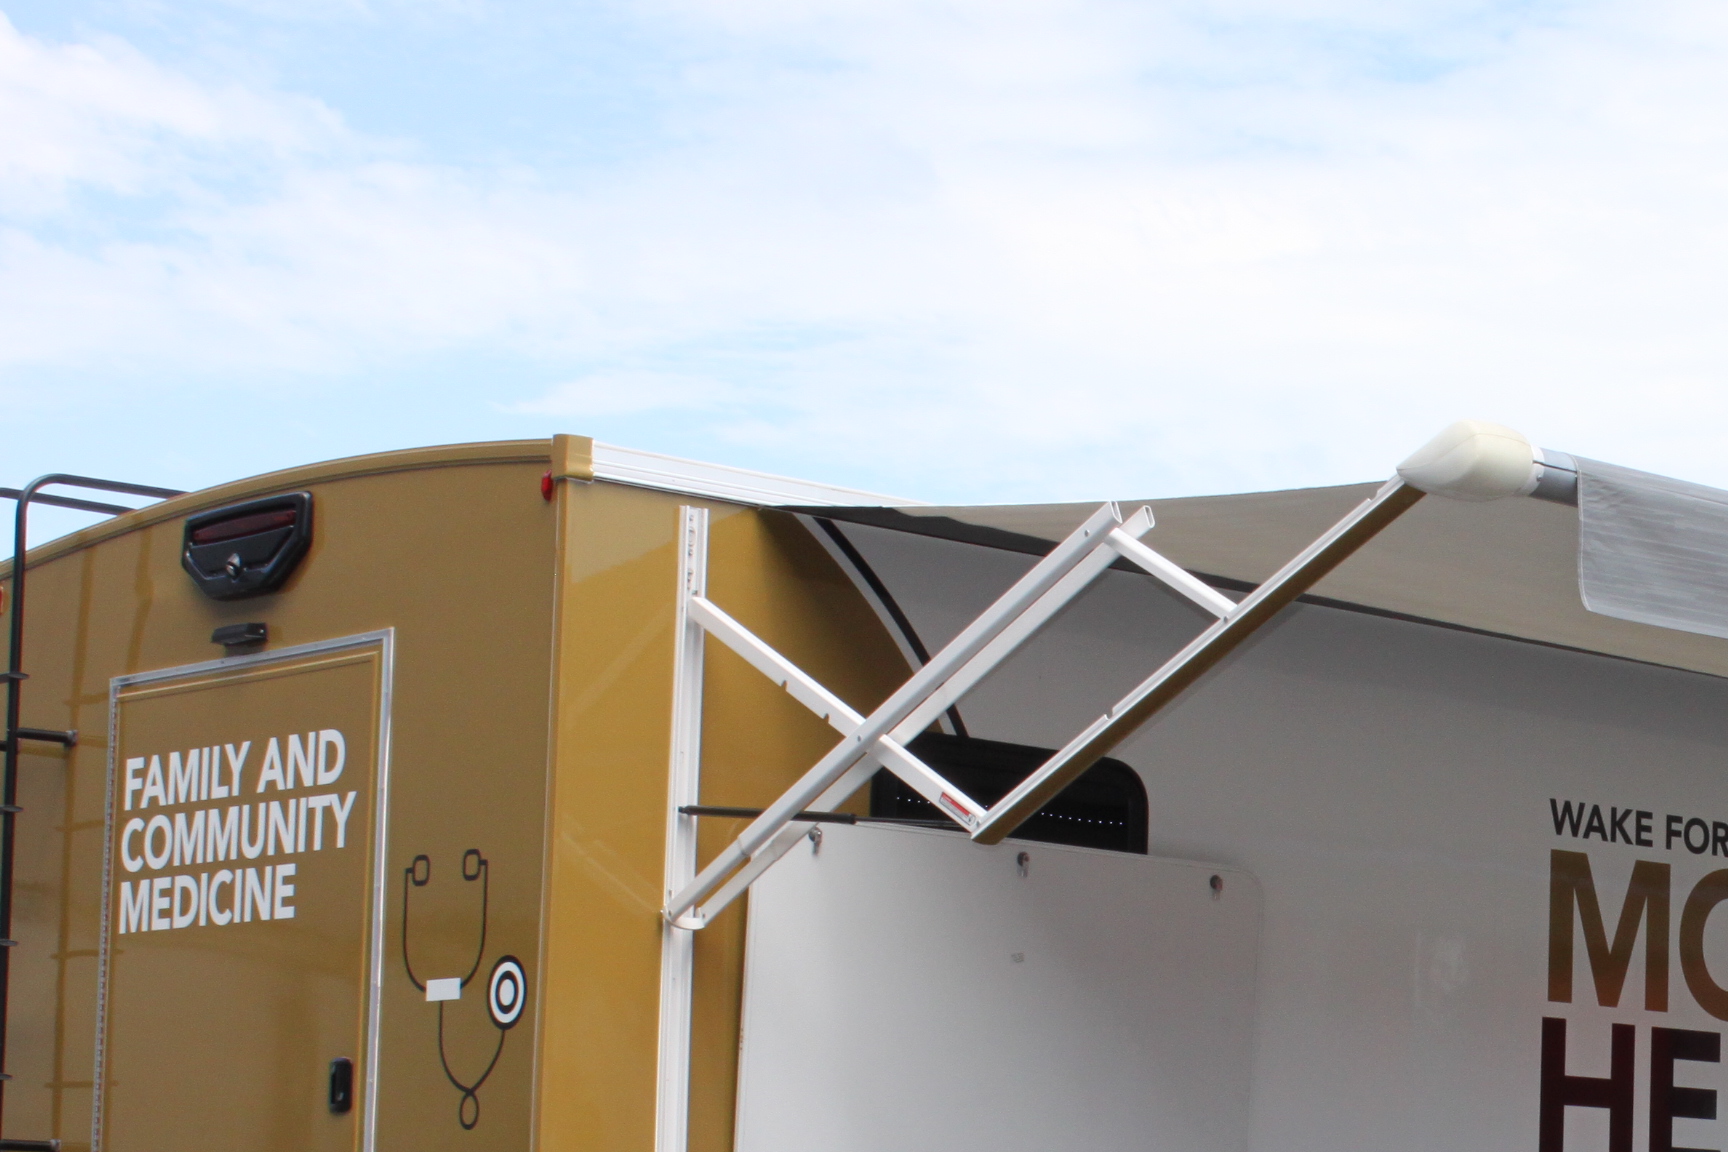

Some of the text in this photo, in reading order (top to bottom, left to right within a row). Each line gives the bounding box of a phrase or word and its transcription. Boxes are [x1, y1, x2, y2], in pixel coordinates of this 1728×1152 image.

[124, 729, 345, 811] FAMILY AND
[121, 791, 357, 872] COMMUNITY
[1549, 798, 1653, 848] WAKE
[118, 864, 296, 934] MEDICINE
